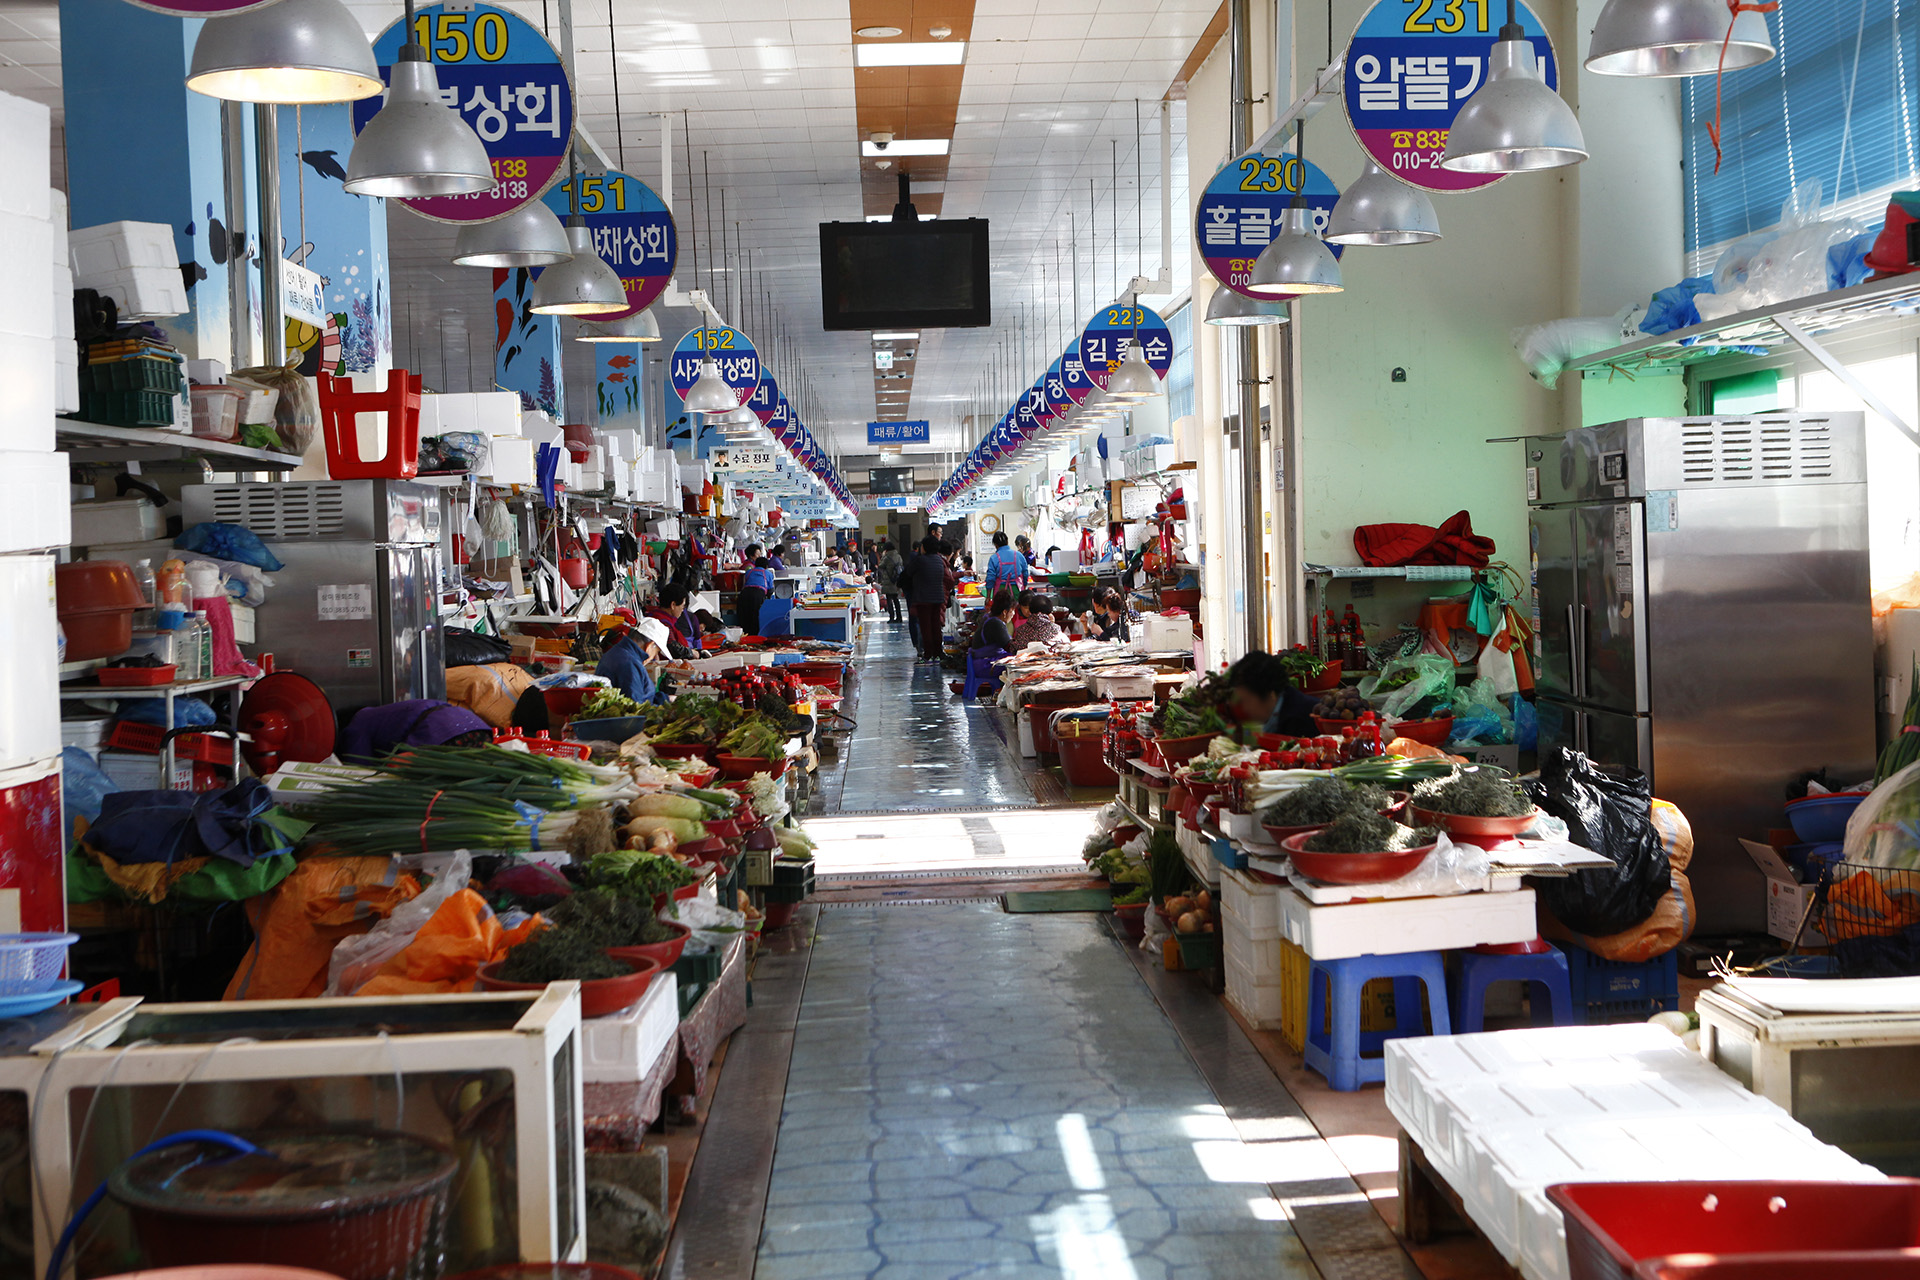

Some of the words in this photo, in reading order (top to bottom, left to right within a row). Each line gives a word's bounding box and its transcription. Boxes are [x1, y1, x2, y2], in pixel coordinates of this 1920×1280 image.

[1403, 0, 1490, 34] 231
[414, 12, 509, 62] 150
[1239, 158, 1306, 192] 230
[561, 177, 626, 213] 151
[1205, 205, 1338, 246] 홀골회
[1108, 308, 1144, 326] 229
[693, 329, 735, 350] 152
[873, 425, 924, 438] 패류/활어
